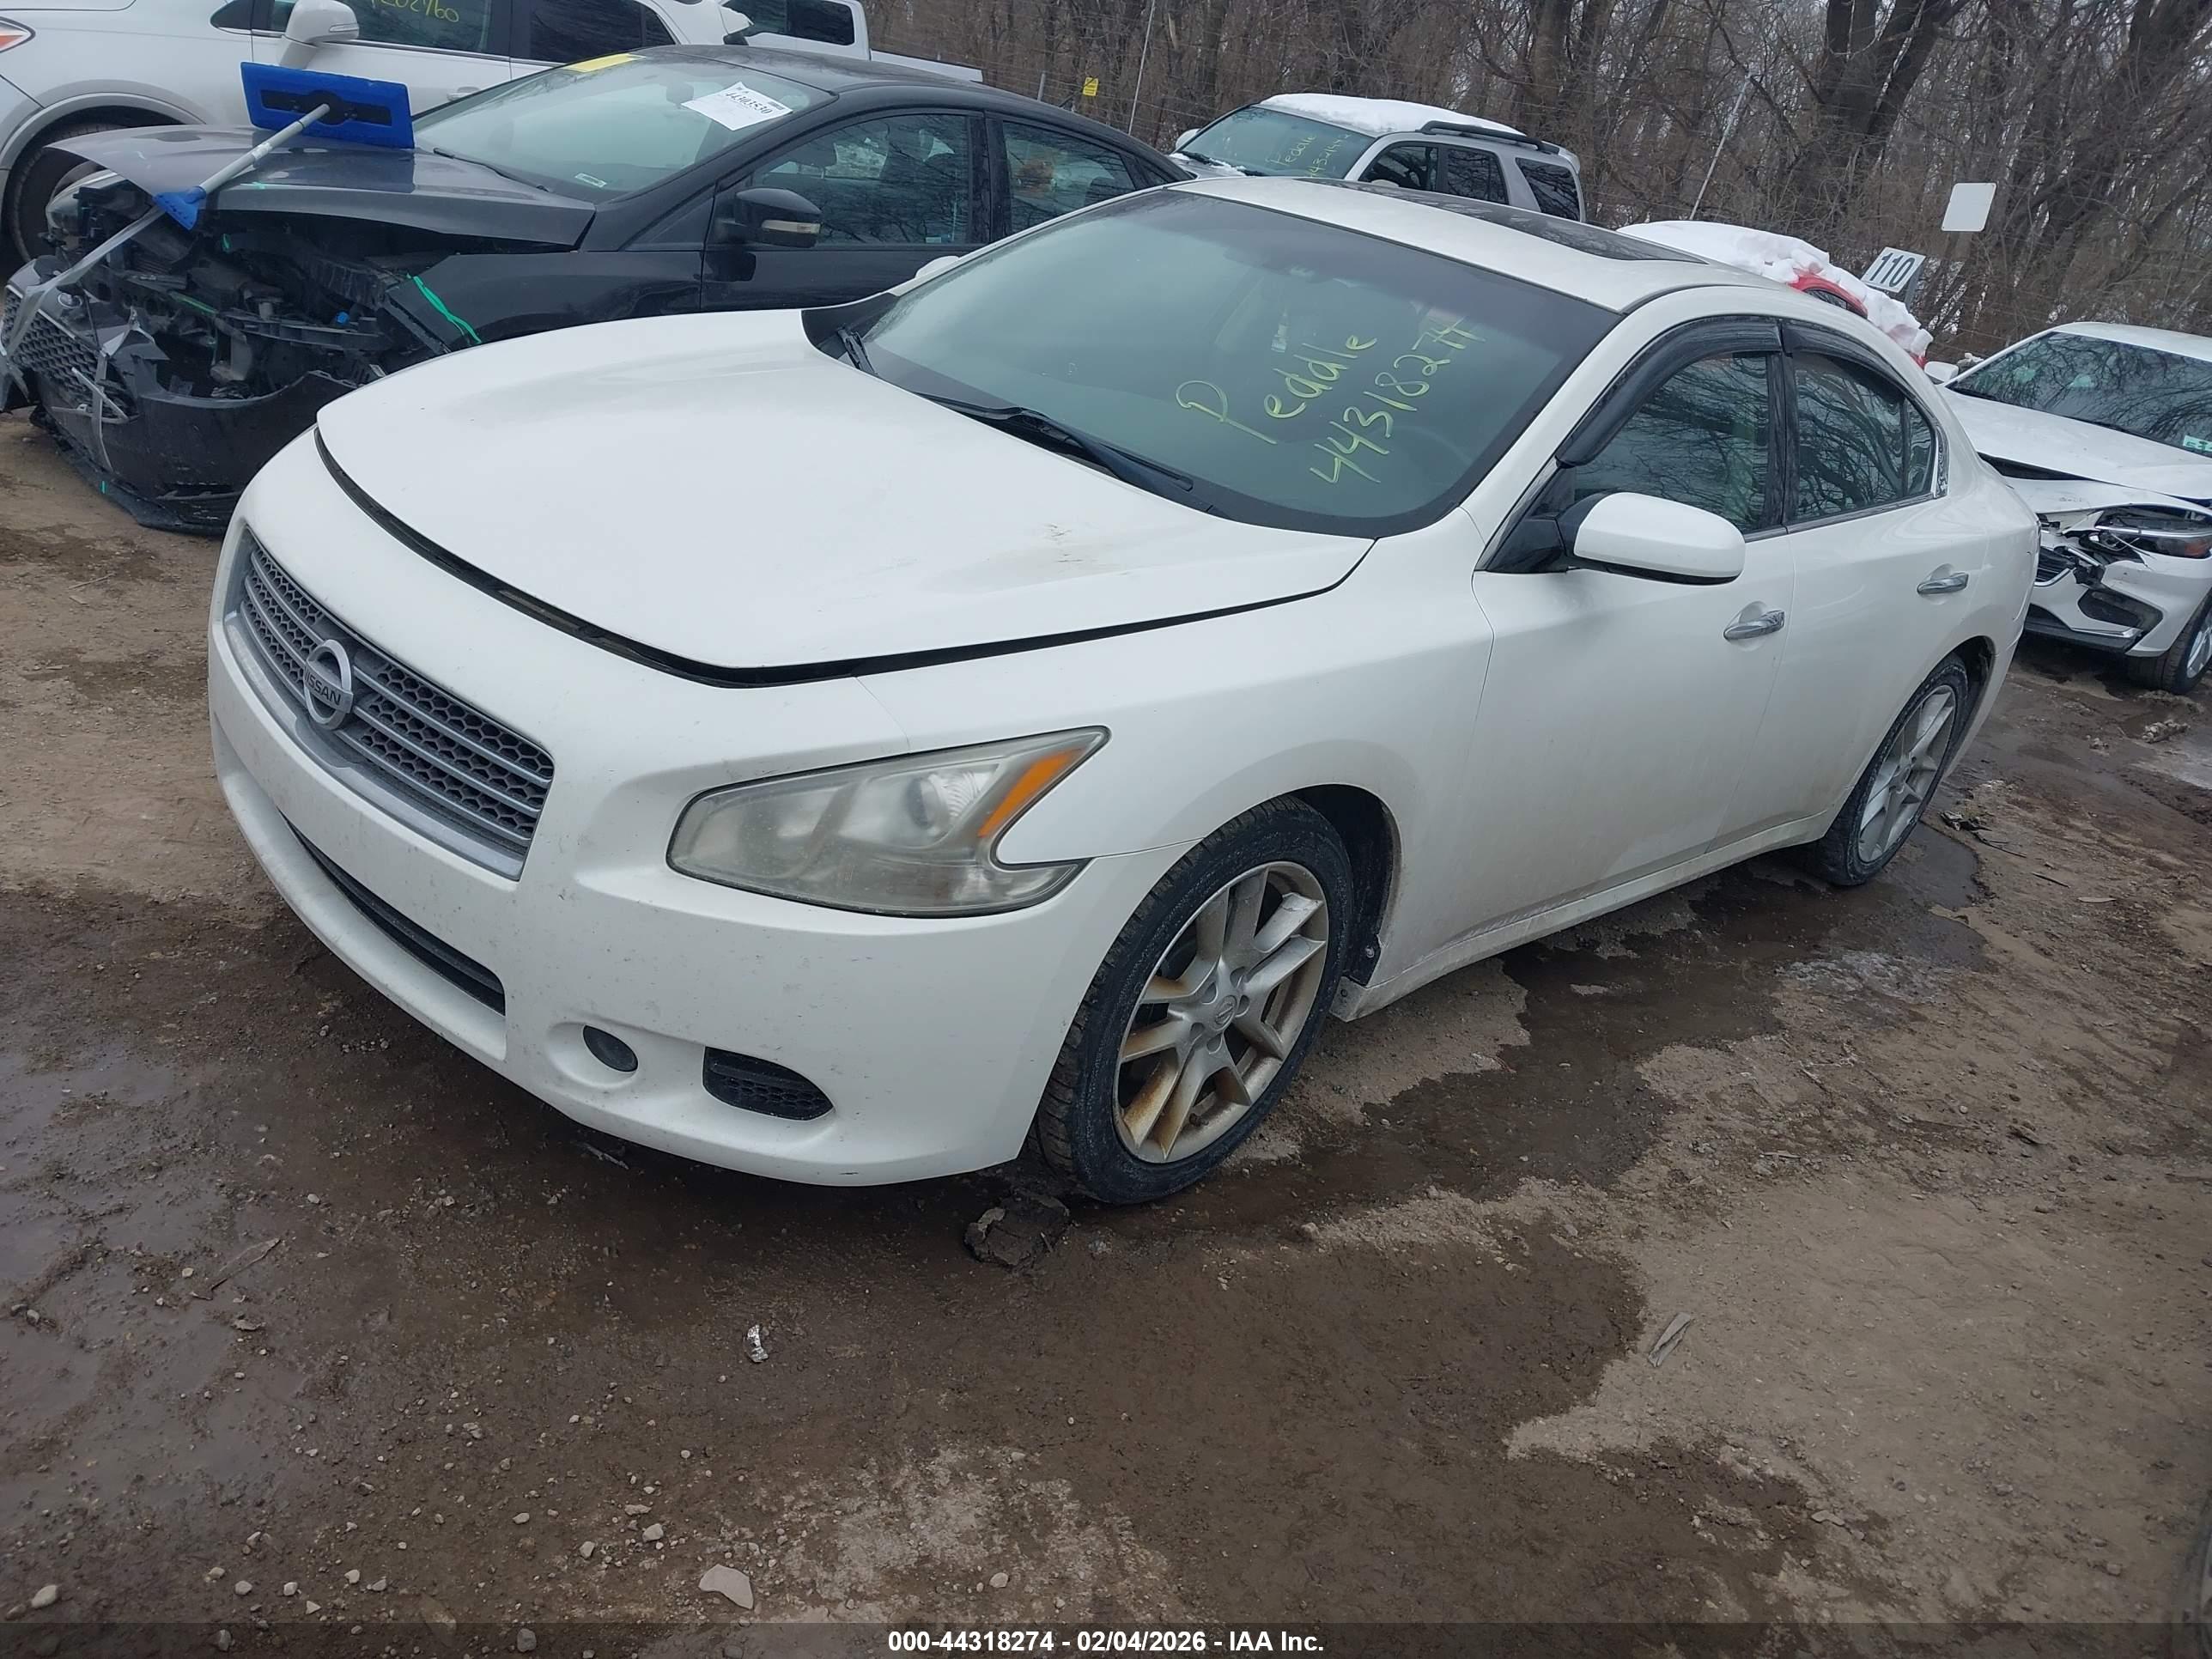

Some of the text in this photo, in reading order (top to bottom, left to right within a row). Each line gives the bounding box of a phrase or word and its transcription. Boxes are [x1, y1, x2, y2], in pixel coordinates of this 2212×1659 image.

[1869, 252, 1916, 288] 110
[1176, 334, 1377, 444] Peddle
[1310, 317, 1486, 483] 44318274
[305, 666, 341, 705] NISSAN
